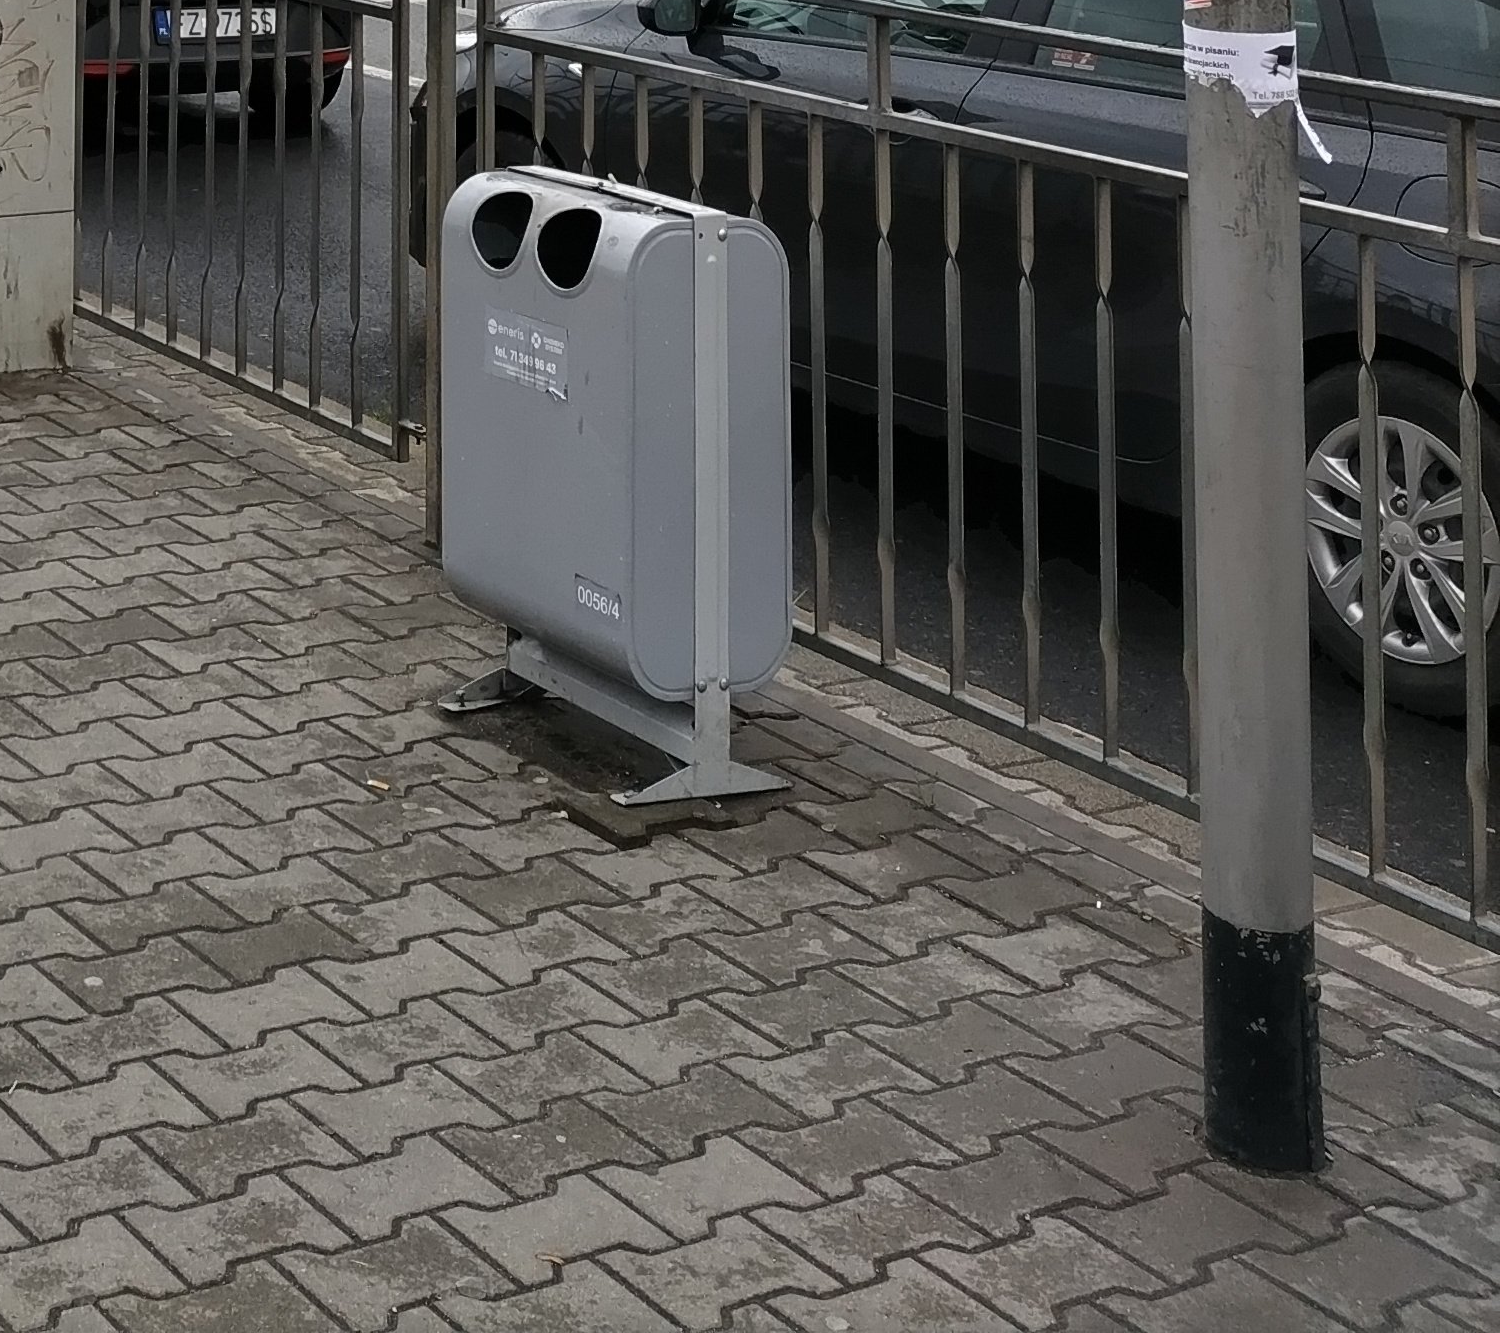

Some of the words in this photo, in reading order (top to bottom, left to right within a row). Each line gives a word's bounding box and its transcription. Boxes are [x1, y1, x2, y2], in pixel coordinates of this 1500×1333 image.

[1205, 46, 1240, 57] pisaniu:
[1252, 92, 1269, 100] Tel.
[498, 324, 524, 341] eneris
[495, 345, 508, 359] tel.
[510, 349, 518, 362] 71
[519, 352, 534, 367] 349
[535, 357, 545, 371] 96
[546, 362, 557, 375] 43
[577, 585, 620, 620] 0056/4
